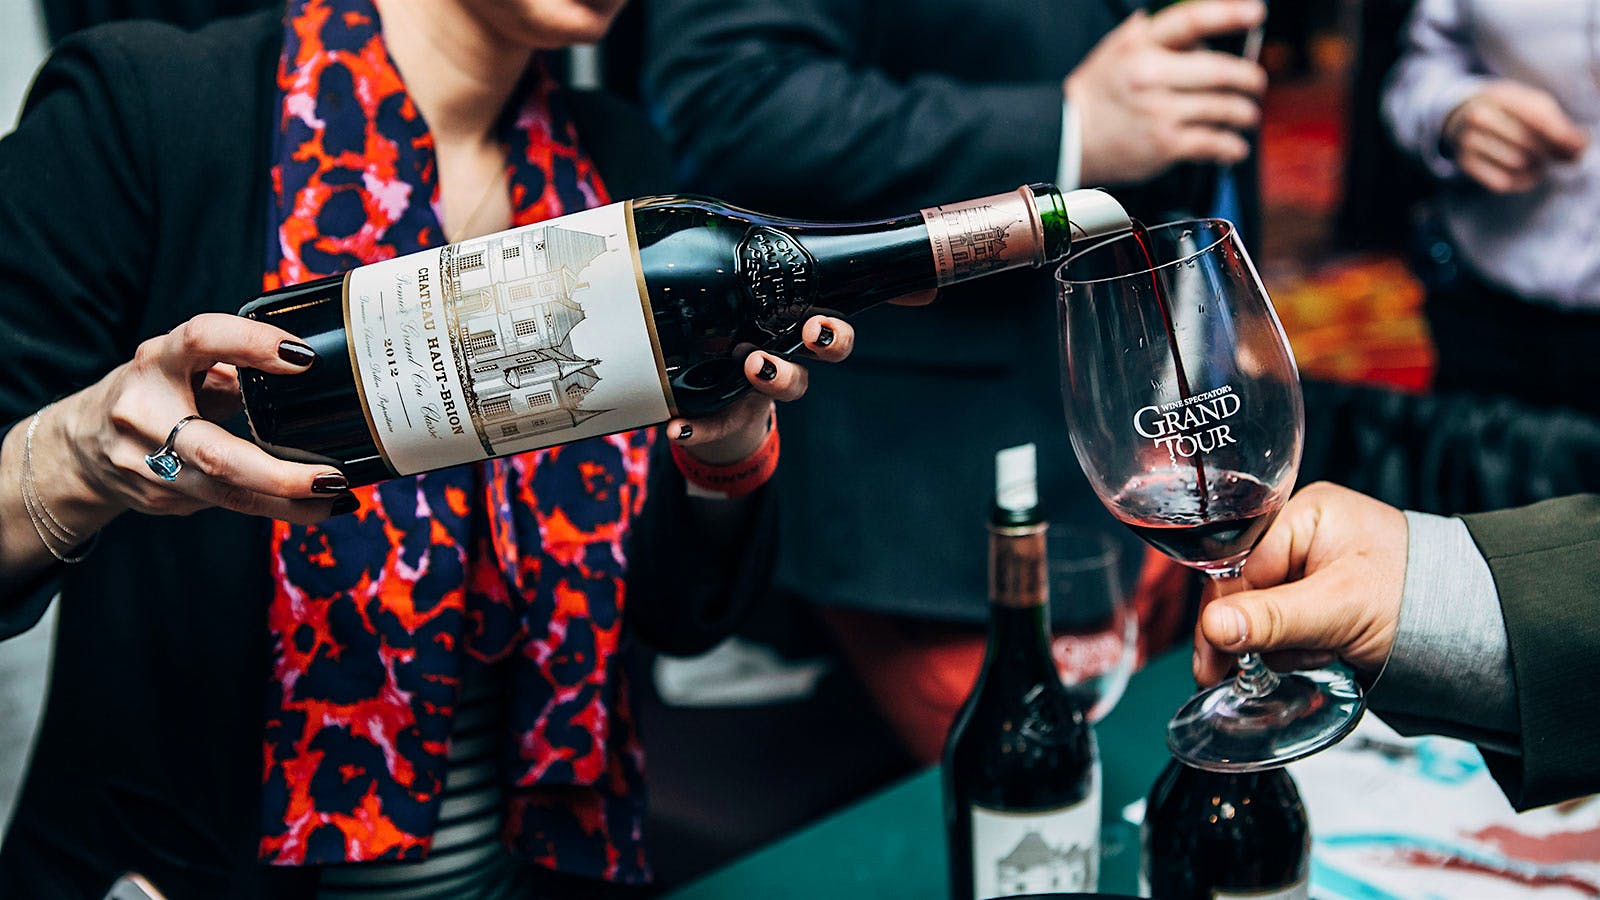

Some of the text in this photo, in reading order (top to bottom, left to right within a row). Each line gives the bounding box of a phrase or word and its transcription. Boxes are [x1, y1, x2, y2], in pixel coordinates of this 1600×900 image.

[384, 338, 399, 378] 2012
[395, 272, 443, 440] Premier Grand Cru Classé
[418, 267, 464, 435] CHATEAU HAUT-BRION
[1133, 394, 1241, 439] GRAND
[1161, 400, 1184, 412] WINE
[1154, 424, 1237, 471] TOUR
